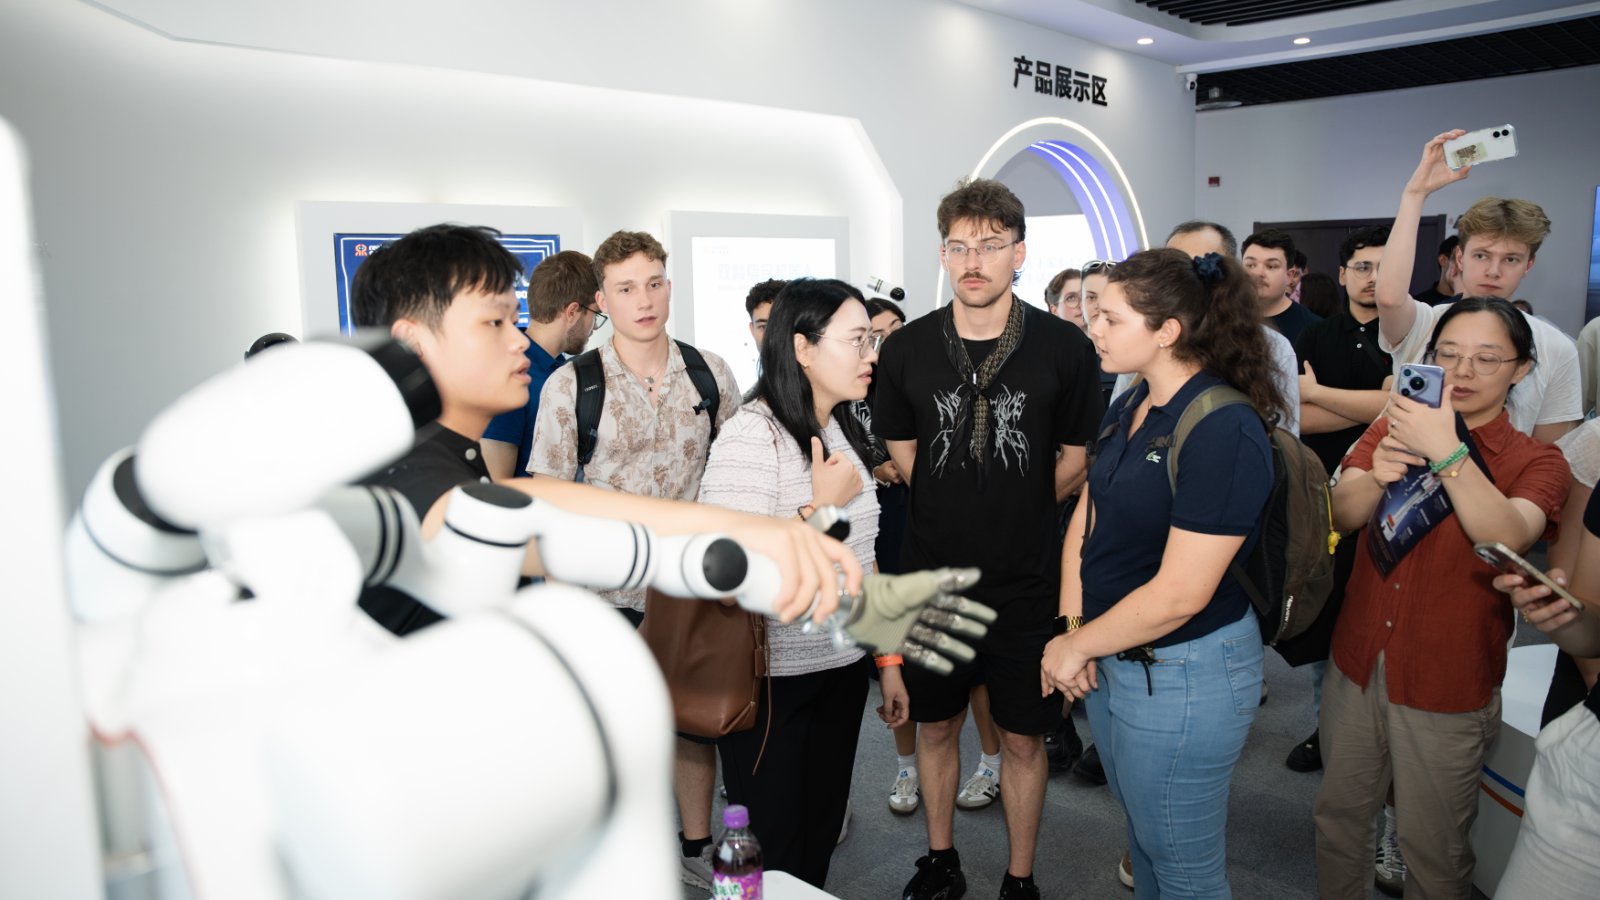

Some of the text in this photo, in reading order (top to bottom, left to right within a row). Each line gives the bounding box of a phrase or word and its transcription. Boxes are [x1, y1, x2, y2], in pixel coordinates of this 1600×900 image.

[1013, 55, 1108, 107] 产品展示区
